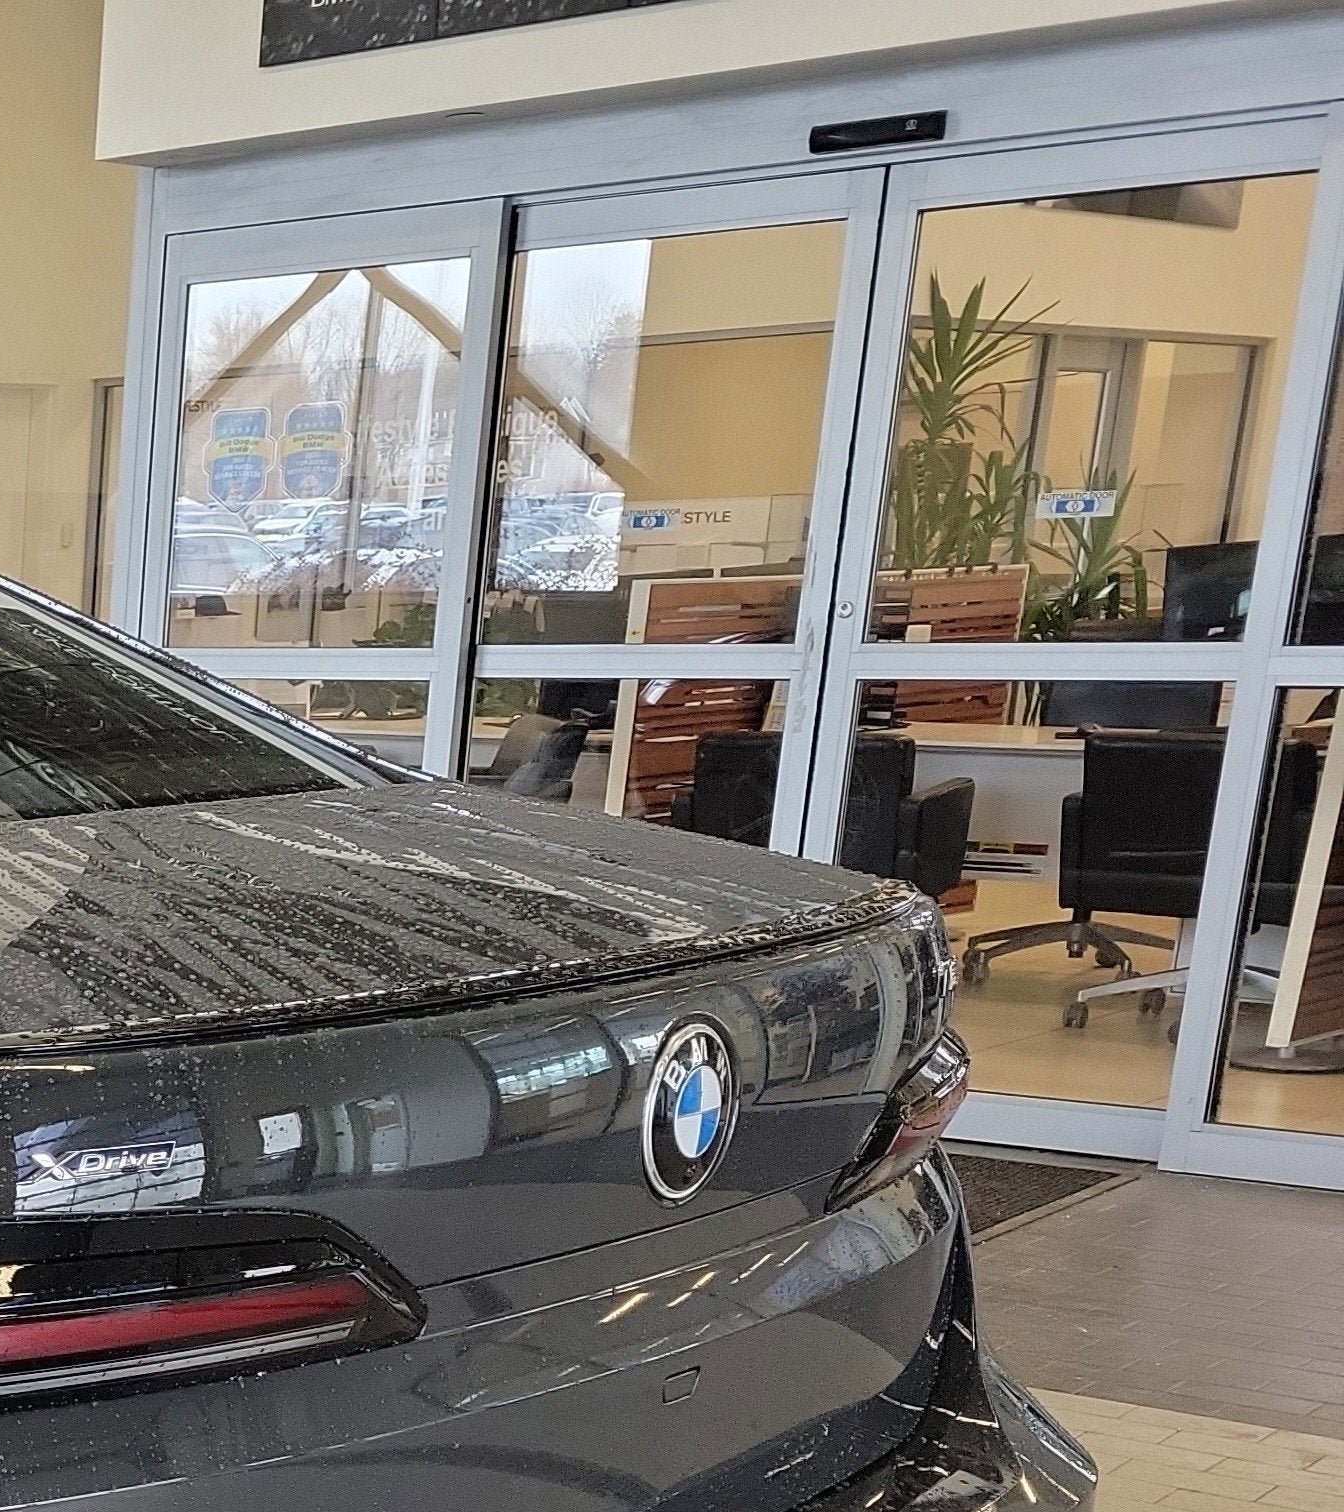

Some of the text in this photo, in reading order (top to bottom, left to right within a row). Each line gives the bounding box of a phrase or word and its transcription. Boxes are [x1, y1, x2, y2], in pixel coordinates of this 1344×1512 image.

[1041, 491, 1114, 501] AUTOMATIC DOOR
[660, 508, 681, 516] DOOR
[664, 1036, 727, 1092] BMW
